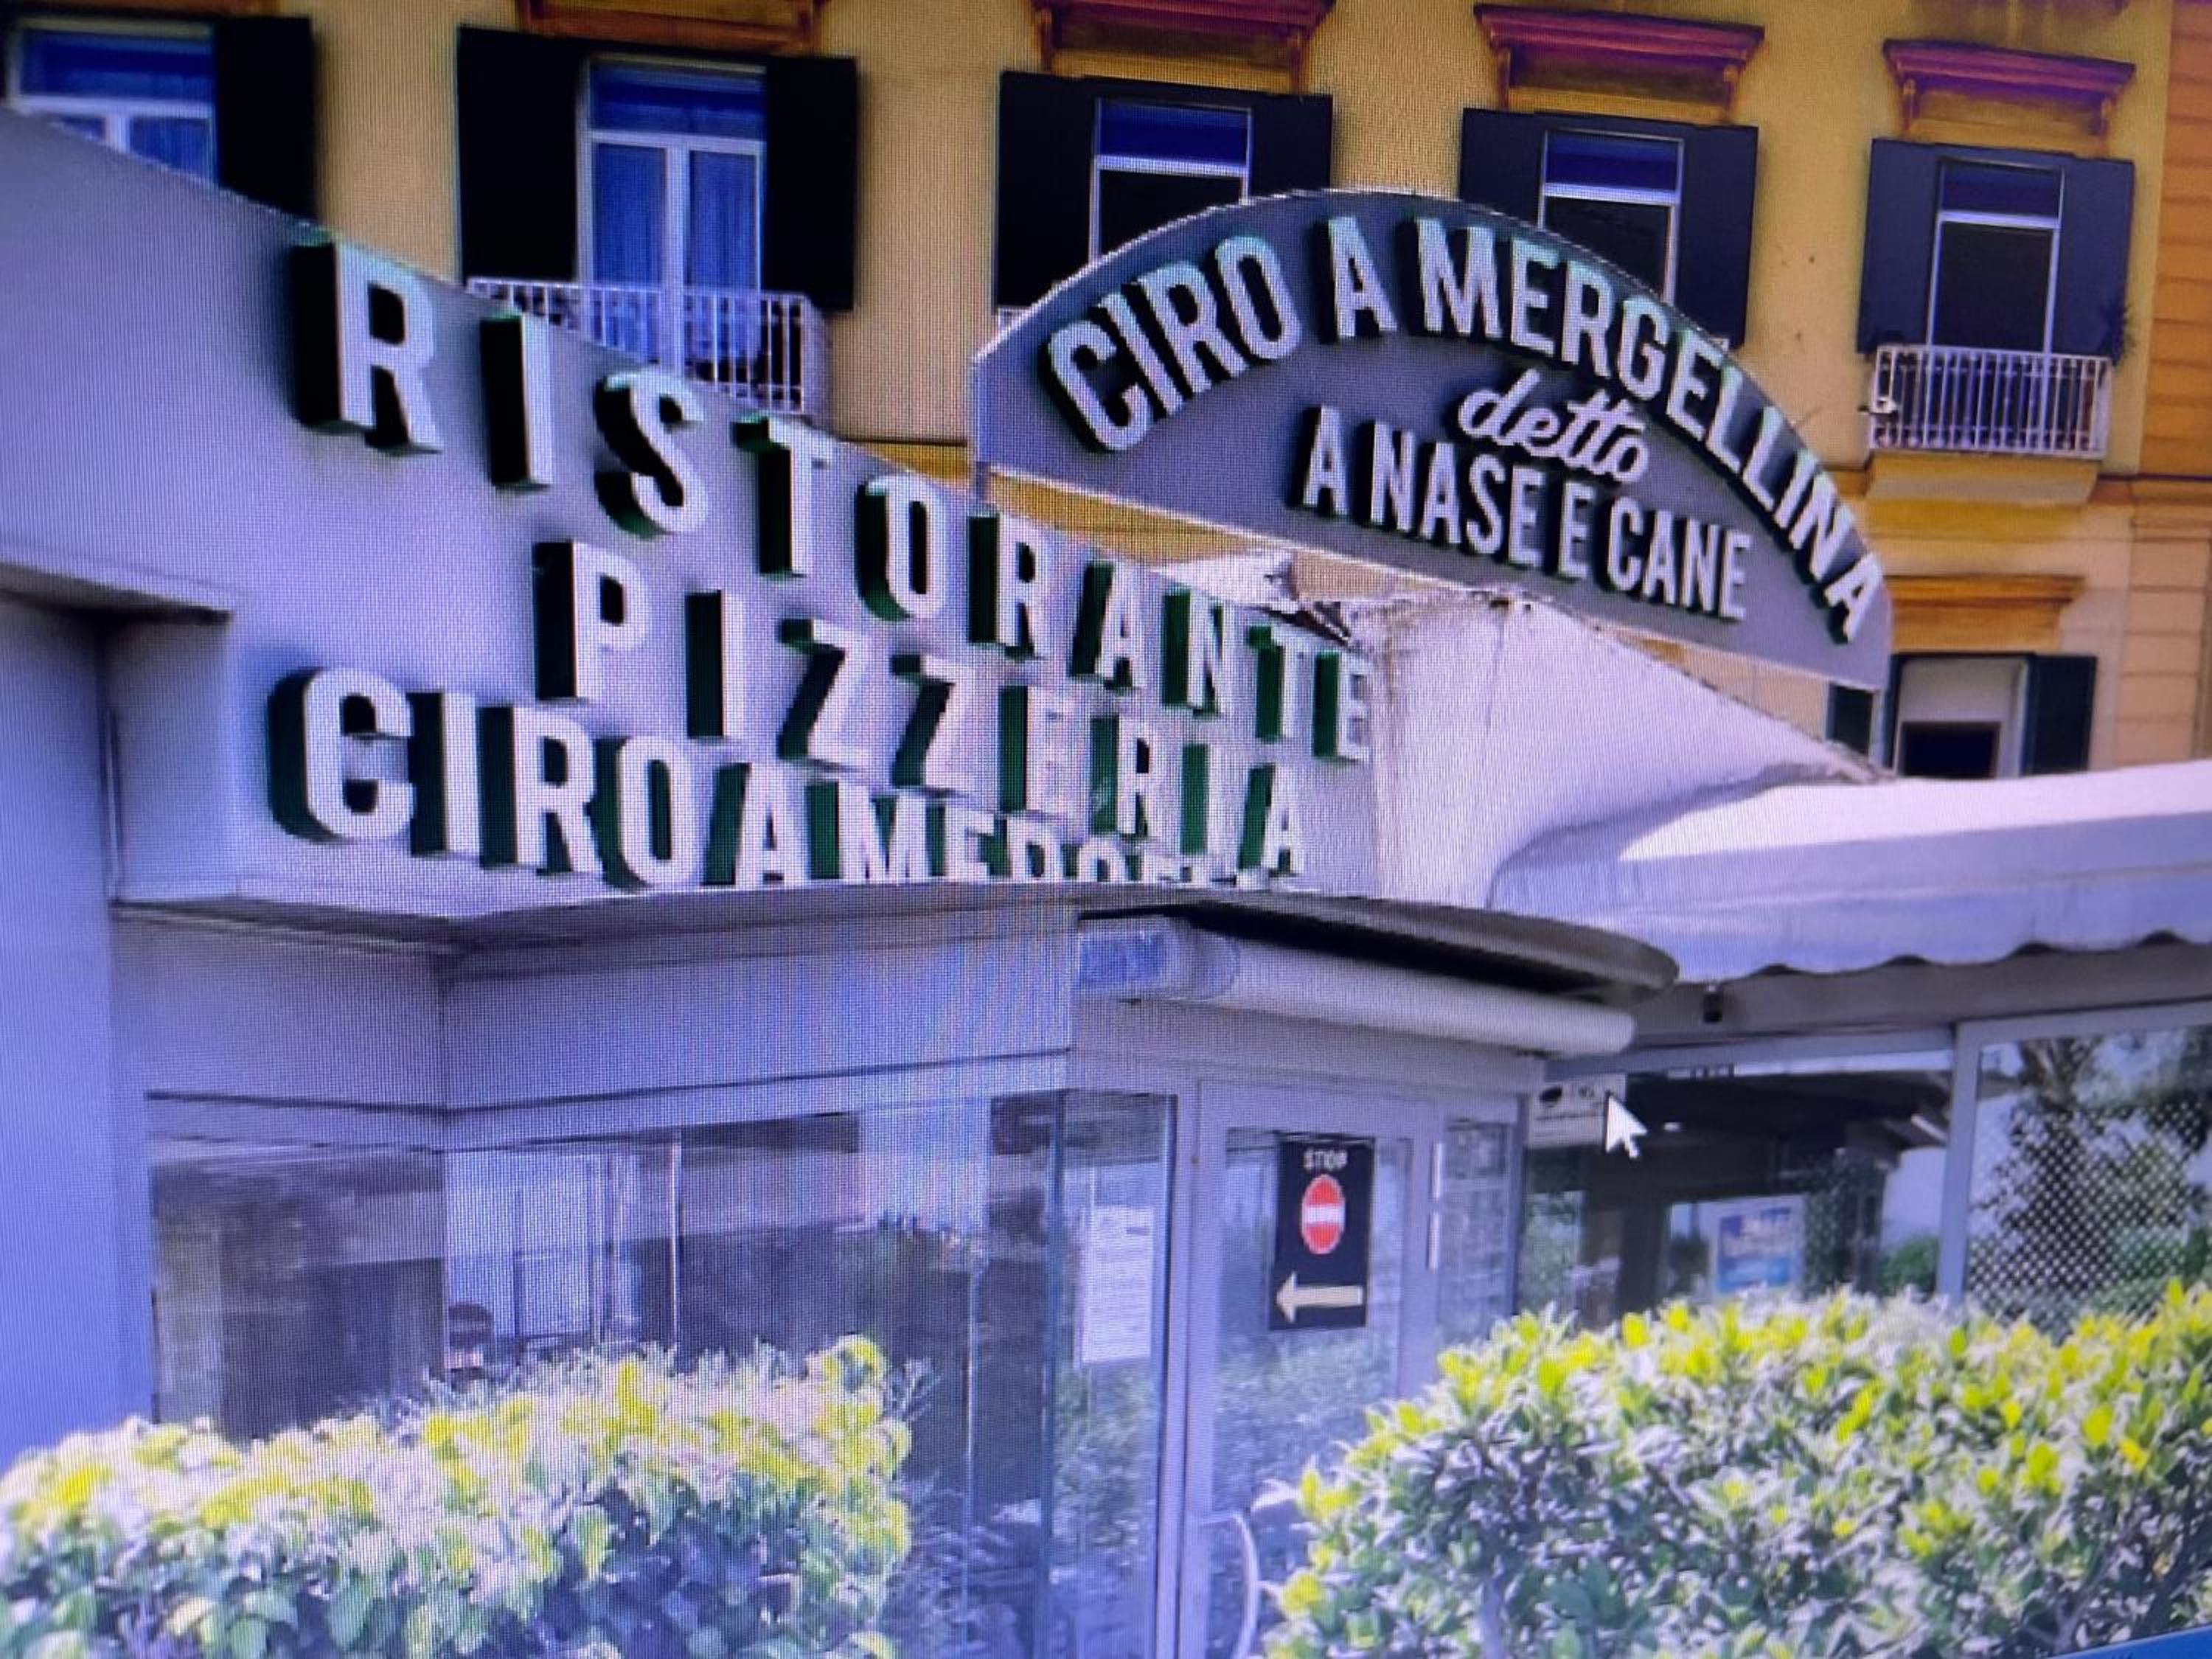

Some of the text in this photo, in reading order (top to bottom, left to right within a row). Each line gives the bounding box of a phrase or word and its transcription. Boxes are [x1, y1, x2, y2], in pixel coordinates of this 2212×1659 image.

[295, 232, 1373, 762] RISTORANTE
[1040, 217, 1885, 643] CIRO A MERGELLINA
[1455, 368, 1650, 484] detto
[1604, 496, 1752, 622] CANE
[534, 540, 1304, 877] PIZZERIA
[1302, 1147, 1348, 1172] STOP
